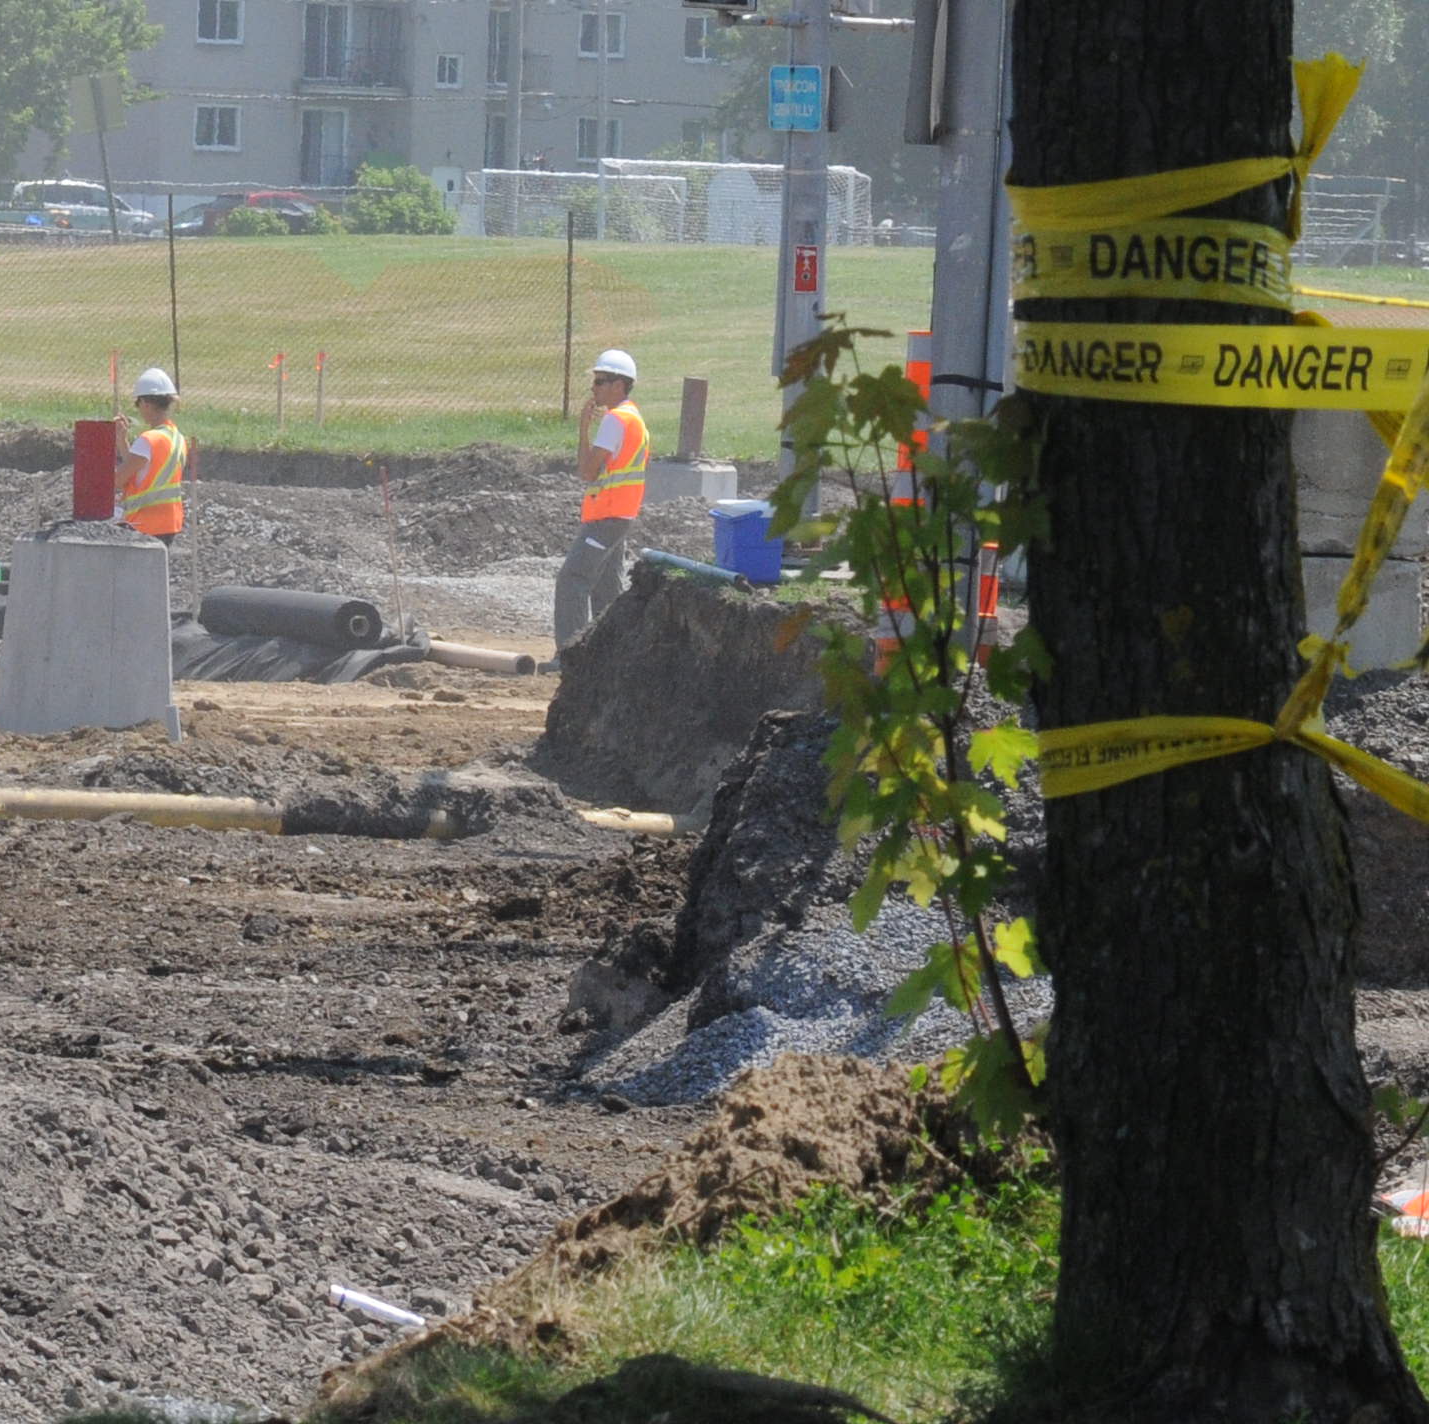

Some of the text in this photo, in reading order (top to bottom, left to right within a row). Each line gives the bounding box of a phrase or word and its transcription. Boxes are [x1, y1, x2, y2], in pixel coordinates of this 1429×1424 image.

[1089, 233, 1270, 288] DANGER
[1023, 338, 1163, 384] DANGER
[1213, 343, 1373, 391] DANGER
